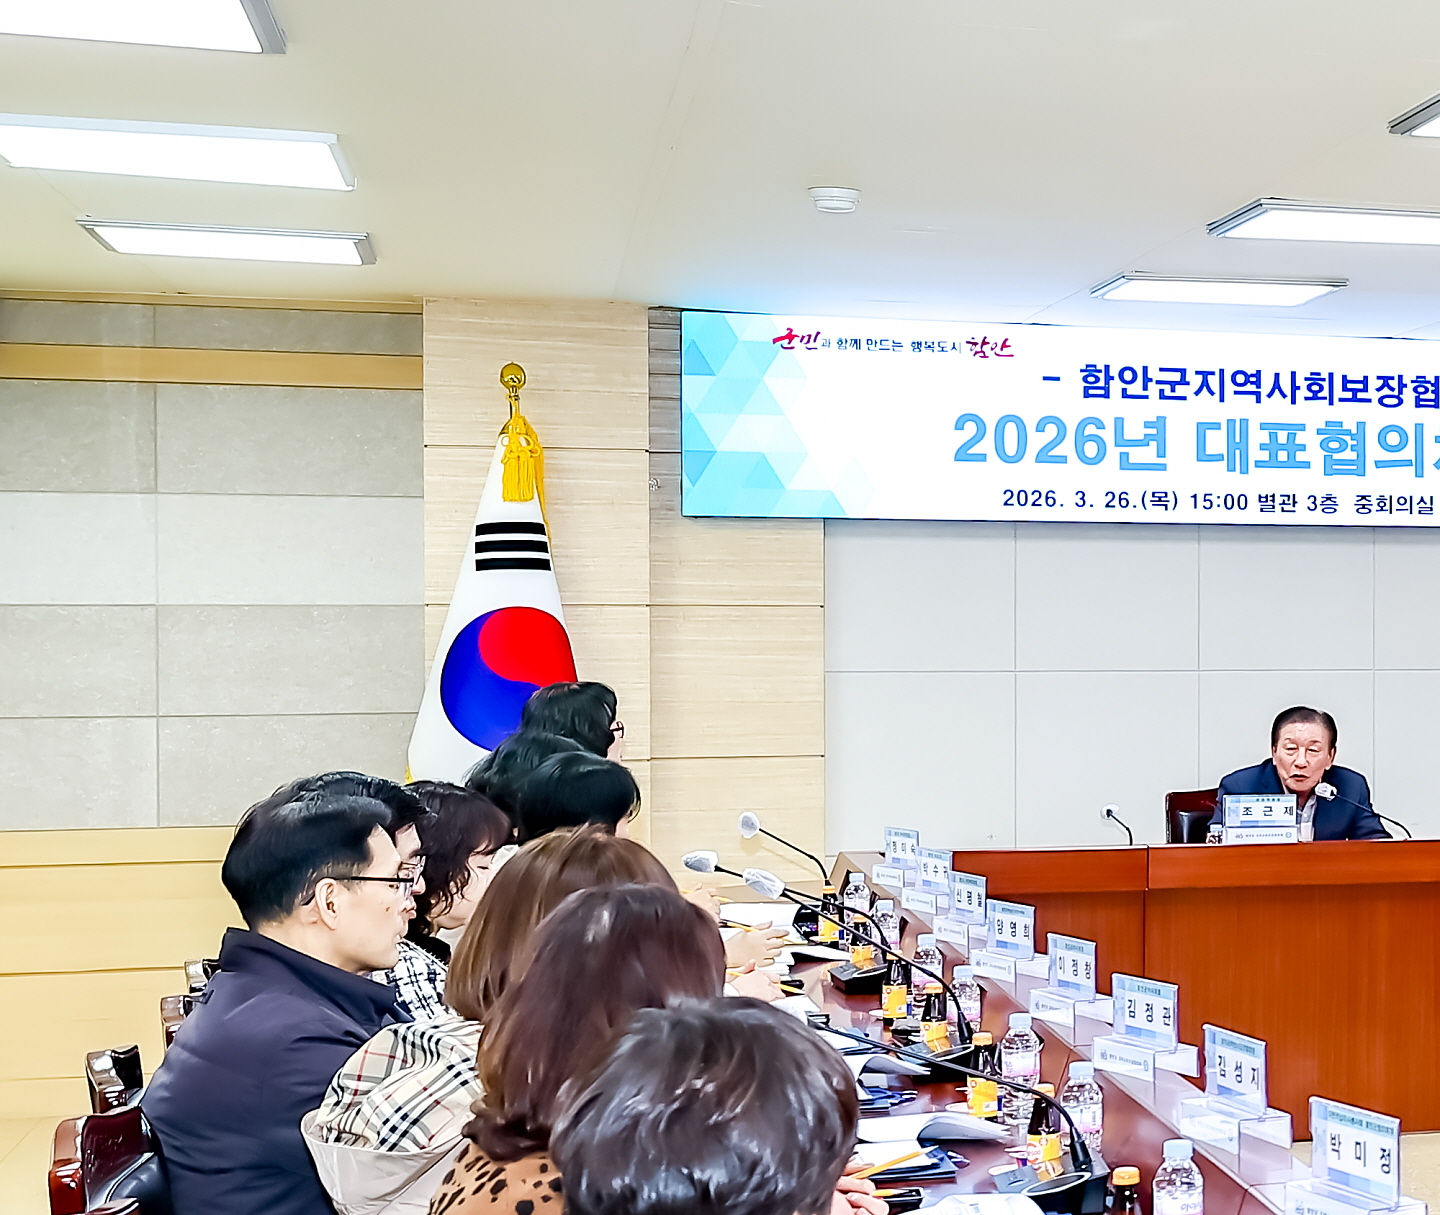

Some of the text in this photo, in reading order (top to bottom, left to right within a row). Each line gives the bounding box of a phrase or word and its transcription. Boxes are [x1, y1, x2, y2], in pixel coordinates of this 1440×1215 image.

[772, 327, 1015, 359] 군민과 함께 만드는 행복도시 함안
[953, 413, 1167, 472] 2026년
[1003, 488, 1065, 508] 2026.
[1074, 490, 1095, 508] 3.
[1104, 490, 1178, 512] 26.(목)
[1190, 493, 1248, 511] 15:00
[1258, 492, 1299, 513] 별관
[1306, 493, 1339, 515] 3층
[1353, 494, 1434, 516] 중회의실
